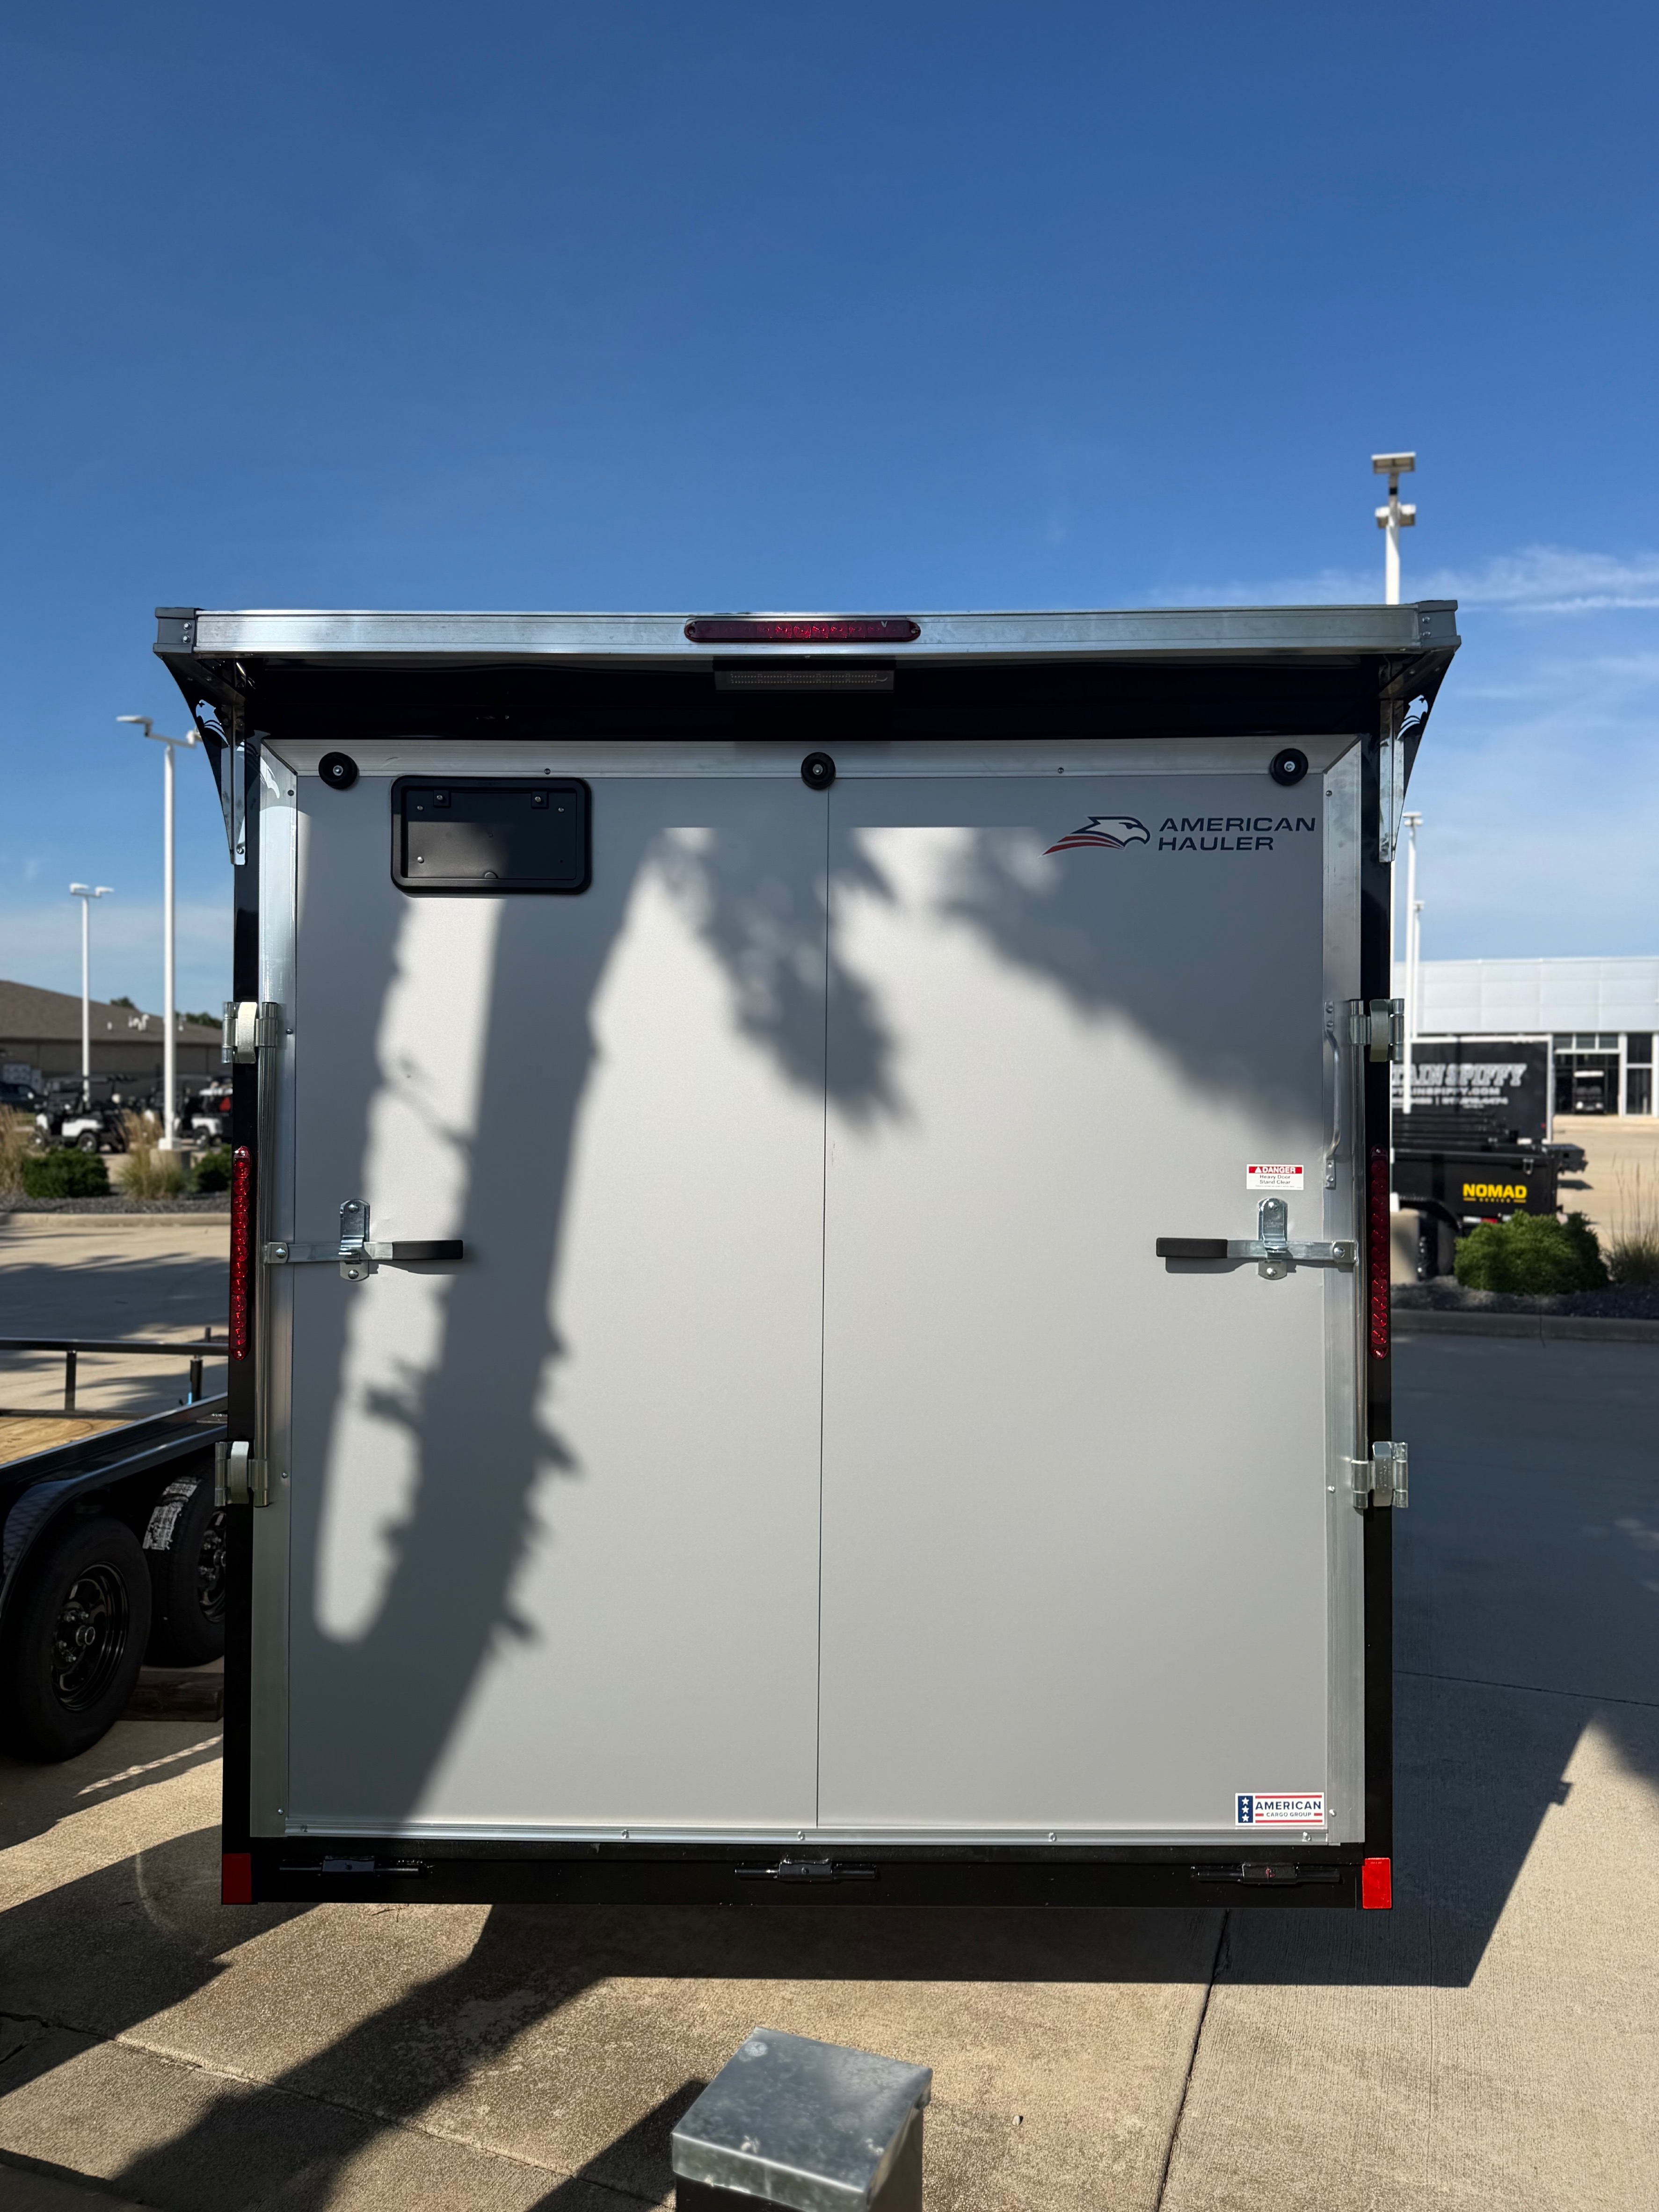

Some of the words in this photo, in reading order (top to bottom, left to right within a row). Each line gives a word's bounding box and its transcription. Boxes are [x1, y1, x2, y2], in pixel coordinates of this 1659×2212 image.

[1159, 818, 1316, 832] AMERICAN
[1158, 837, 1273, 851] HAULER
[1463, 1183, 1527, 1198] NOMAD
[1255, 1801, 1321, 1810] AMERICAN
